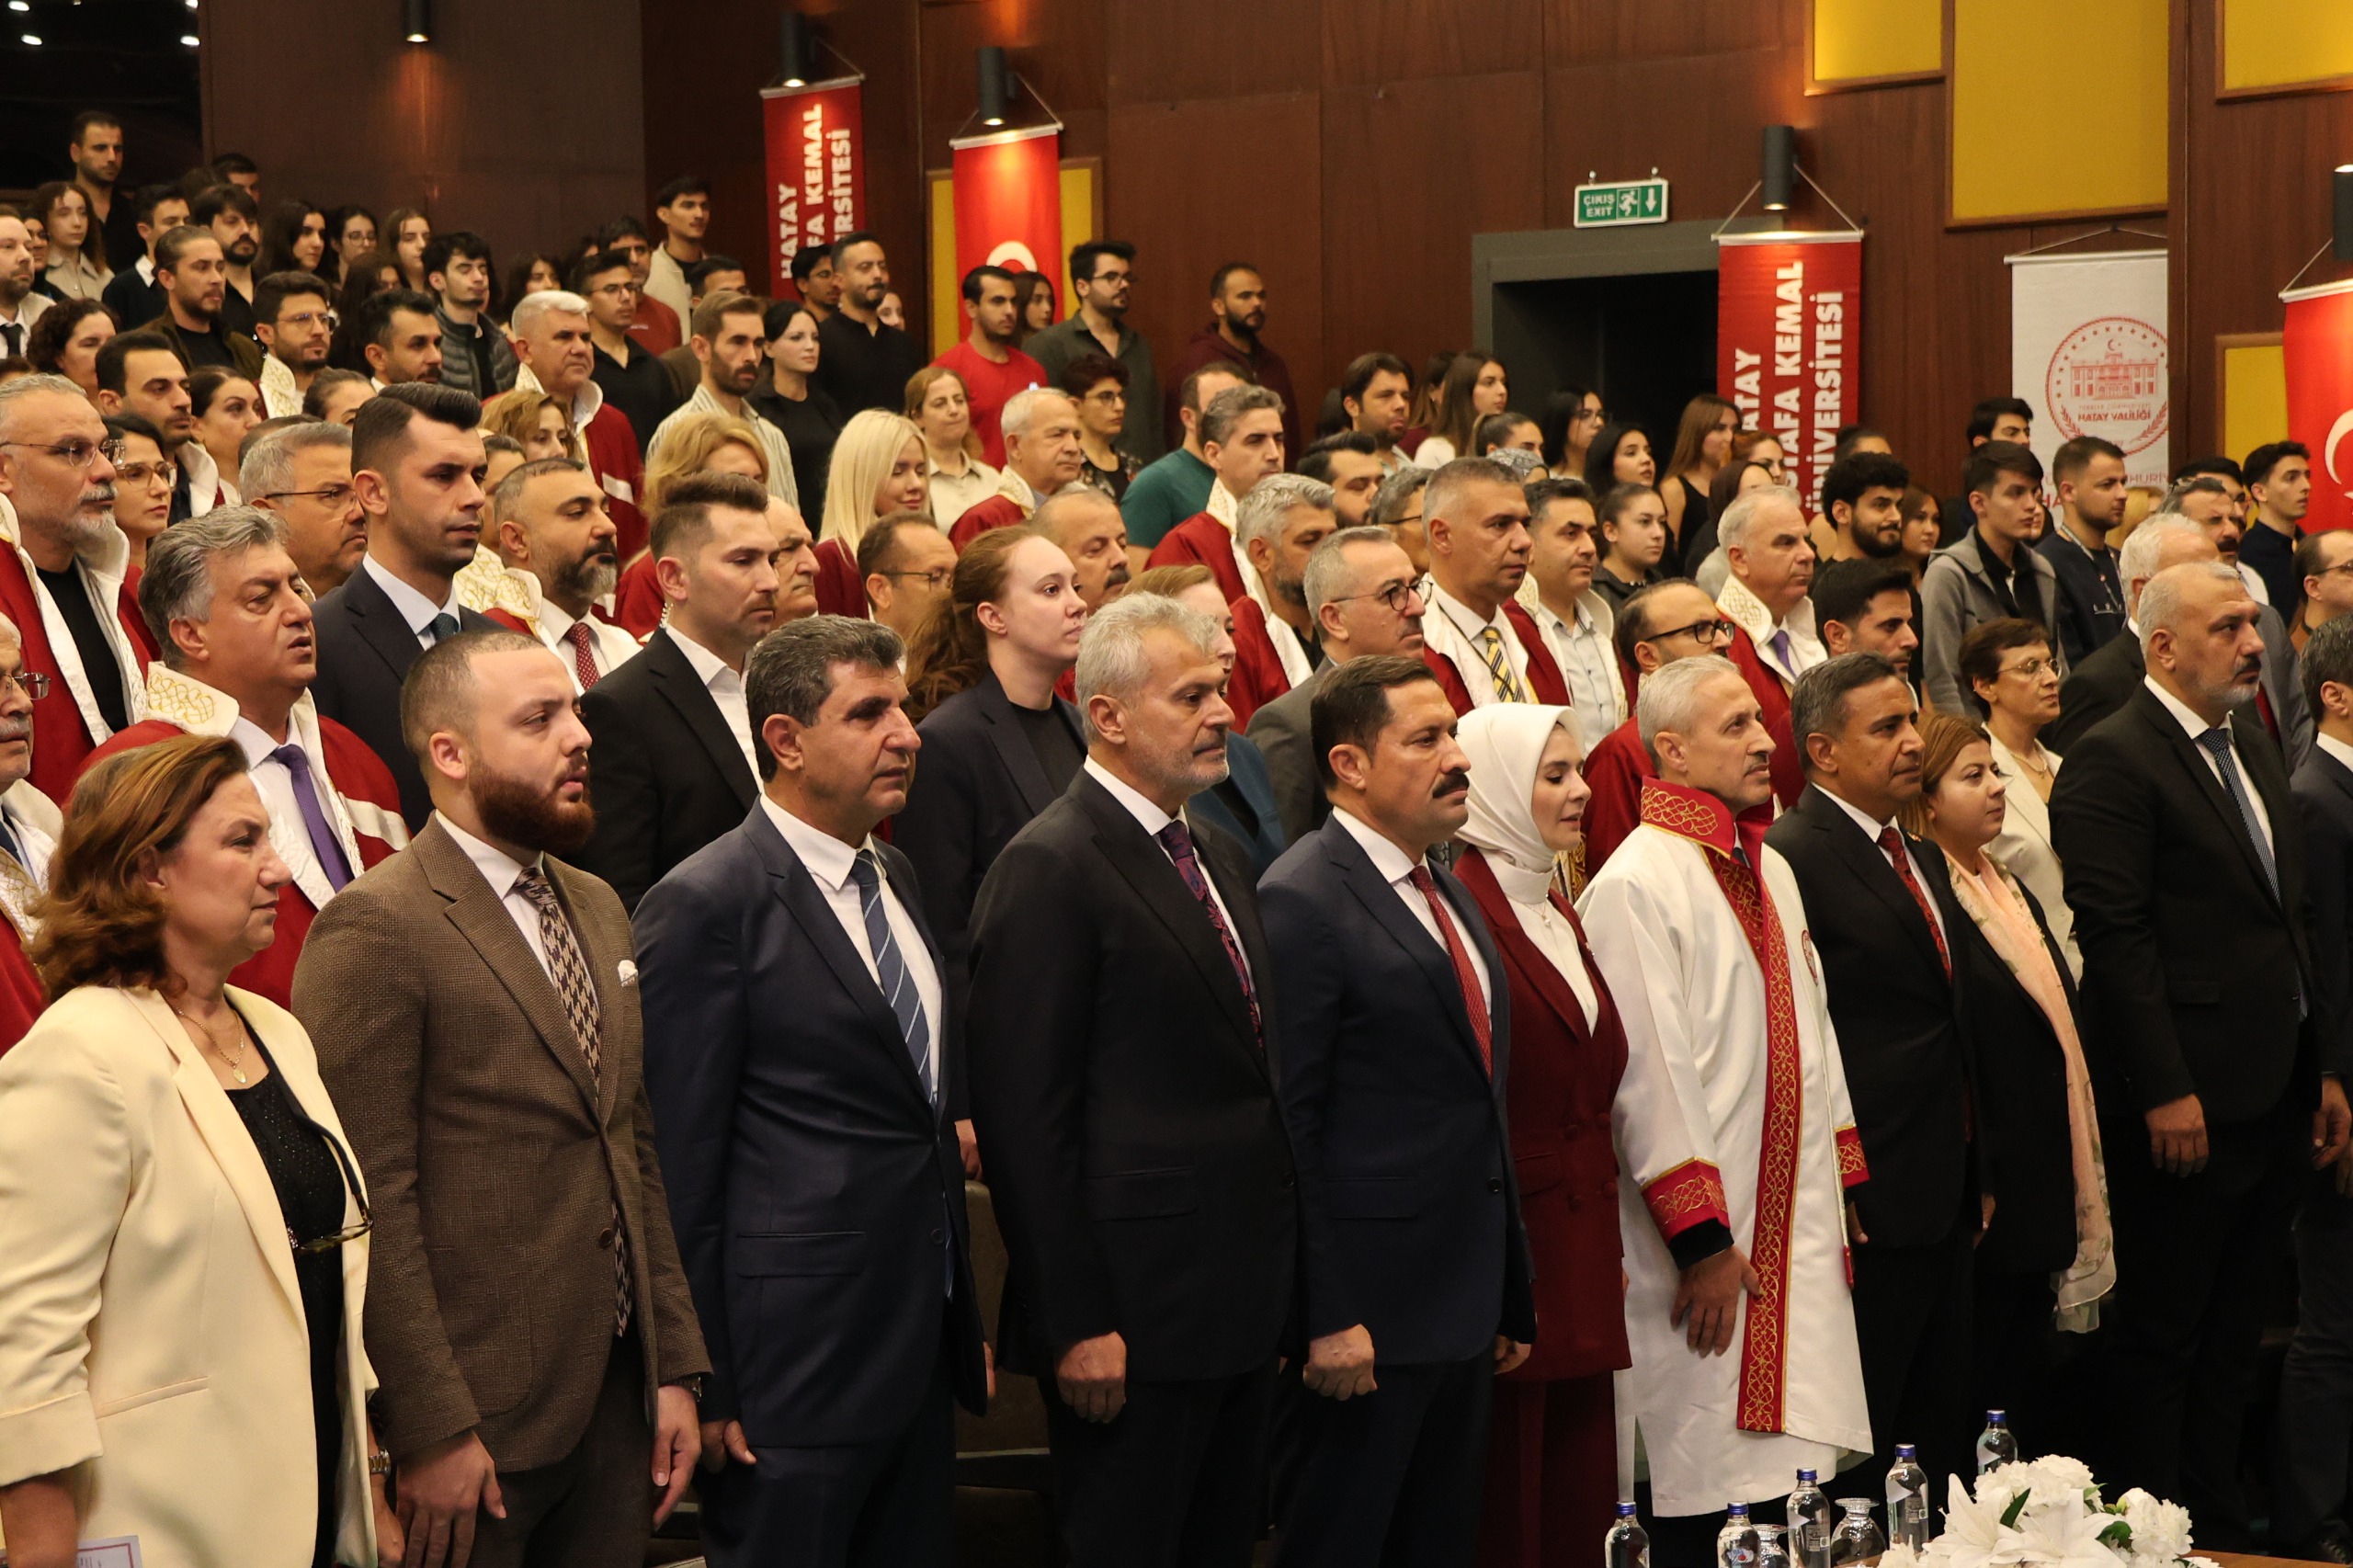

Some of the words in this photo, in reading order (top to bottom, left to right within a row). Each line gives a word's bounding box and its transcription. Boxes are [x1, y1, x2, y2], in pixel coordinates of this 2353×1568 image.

[802, 103, 824, 205] KEMAL
[779, 183, 799, 278] HATAY
[1586, 206, 1613, 218] EXIT
[1775, 261, 1804, 376] KEMAL
[1734, 347, 1761, 430] ATAY
[2078, 412, 2109, 422] HATAY
